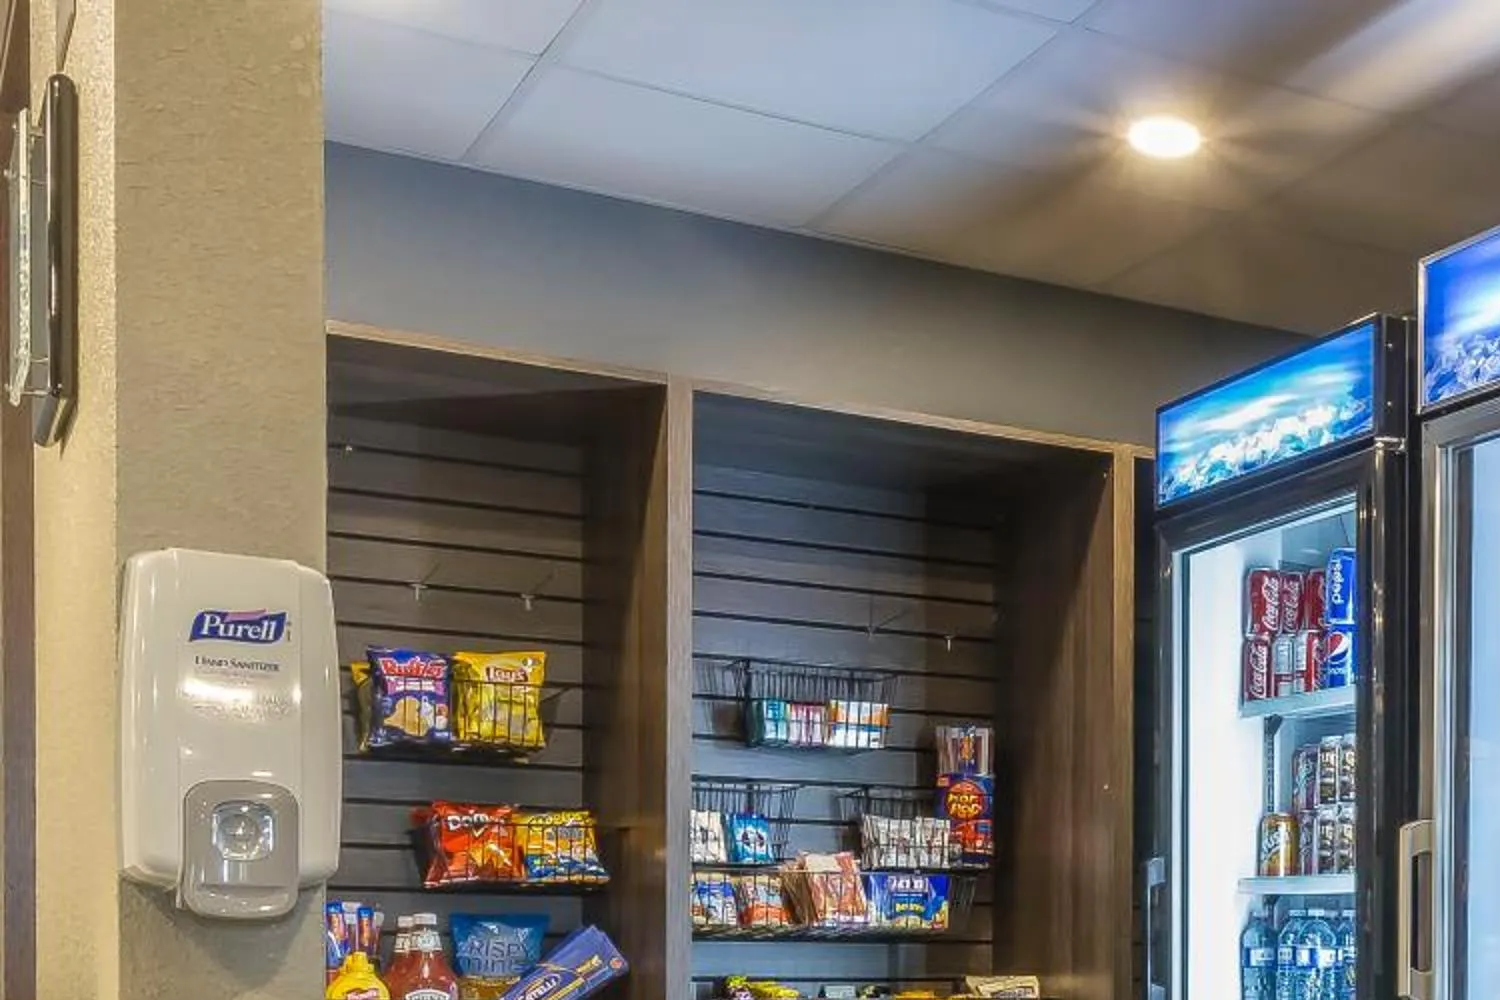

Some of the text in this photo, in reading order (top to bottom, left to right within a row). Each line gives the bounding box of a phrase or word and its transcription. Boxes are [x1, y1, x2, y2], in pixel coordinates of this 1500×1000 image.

[1332, 560, 1344, 604] pepsi
[200, 613, 277, 641] Purell
[230, 658, 280, 672] SANITIZER
